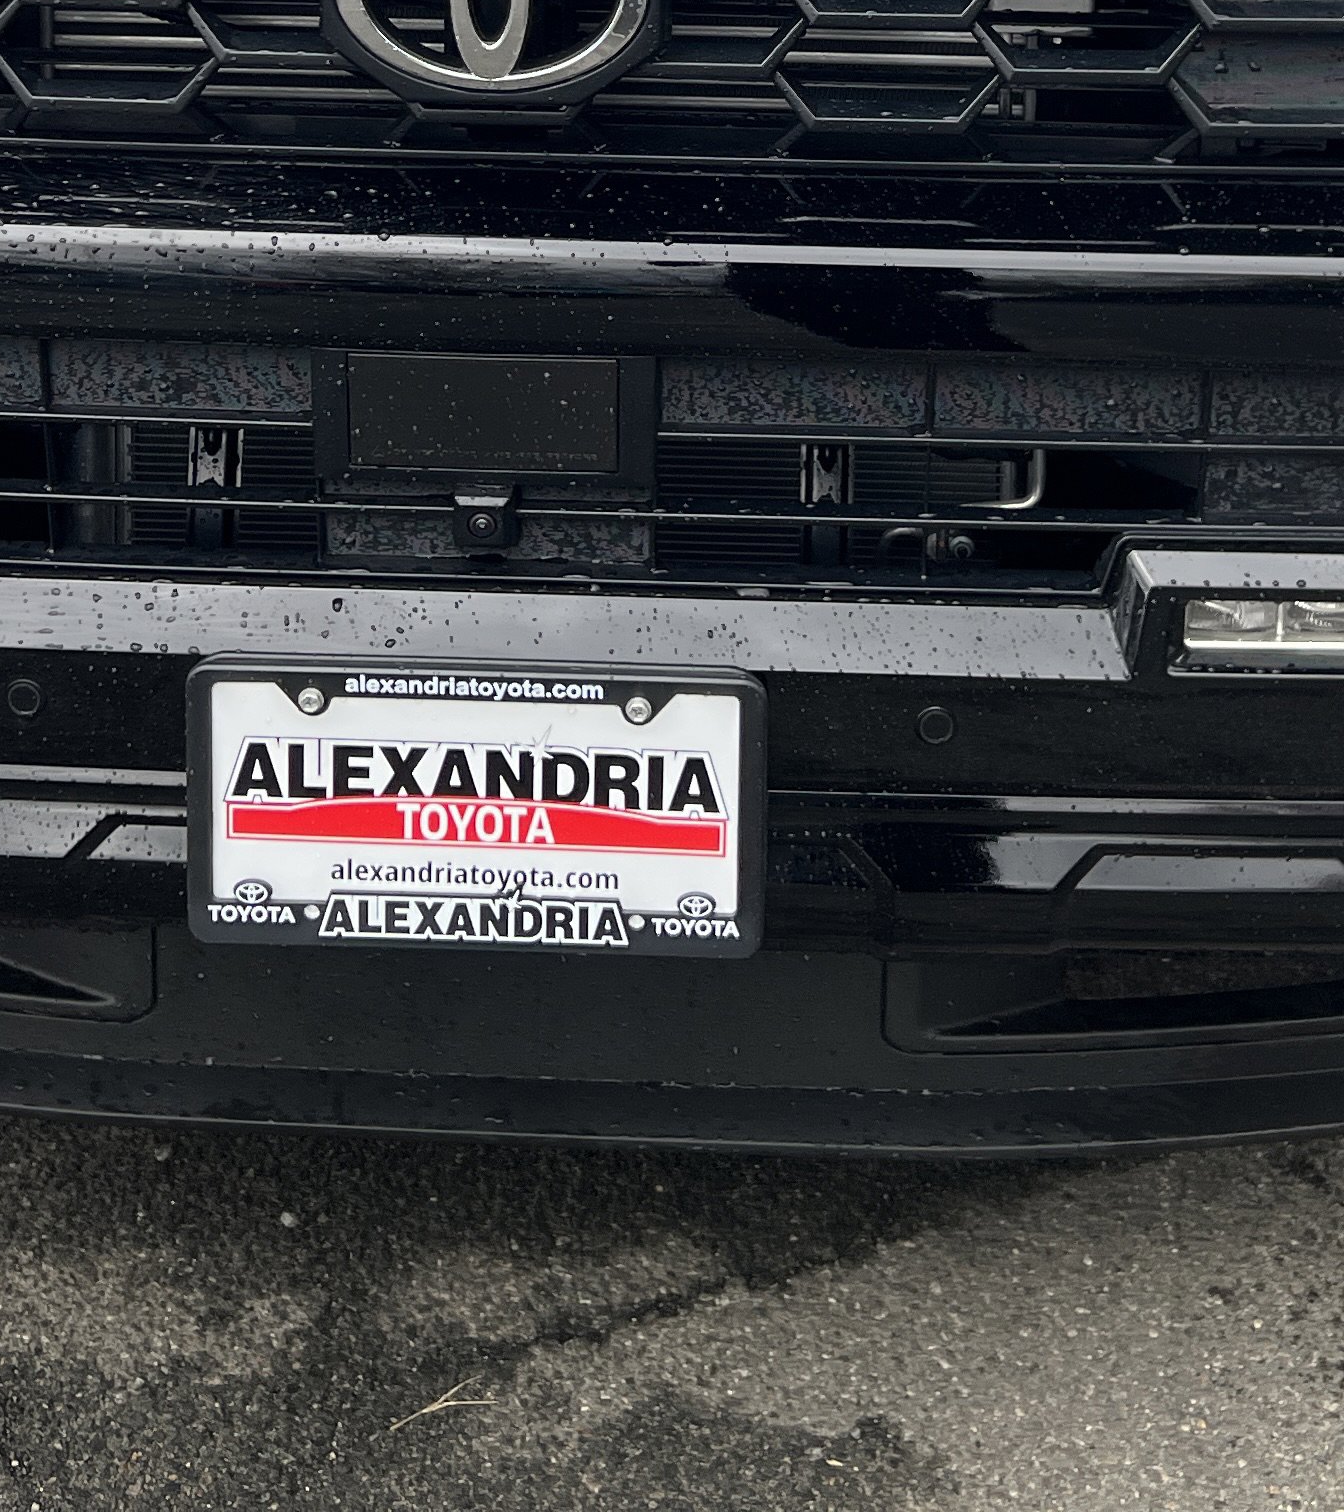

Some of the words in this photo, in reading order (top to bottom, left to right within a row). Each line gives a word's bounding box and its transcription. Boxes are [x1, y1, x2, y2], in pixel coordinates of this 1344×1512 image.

[344, 675, 604, 701] alexandriatoyota.com
[231, 739, 722, 814] ALEXANDRIA
[396, 802, 556, 845] TOYOTA
[330, 859, 620, 891] alexandriatoyota.com
[207, 904, 297, 925] TOYOTA
[320, 894, 629, 945] ALEXANDRIA
[651, 916, 740, 940] TOYOTA
